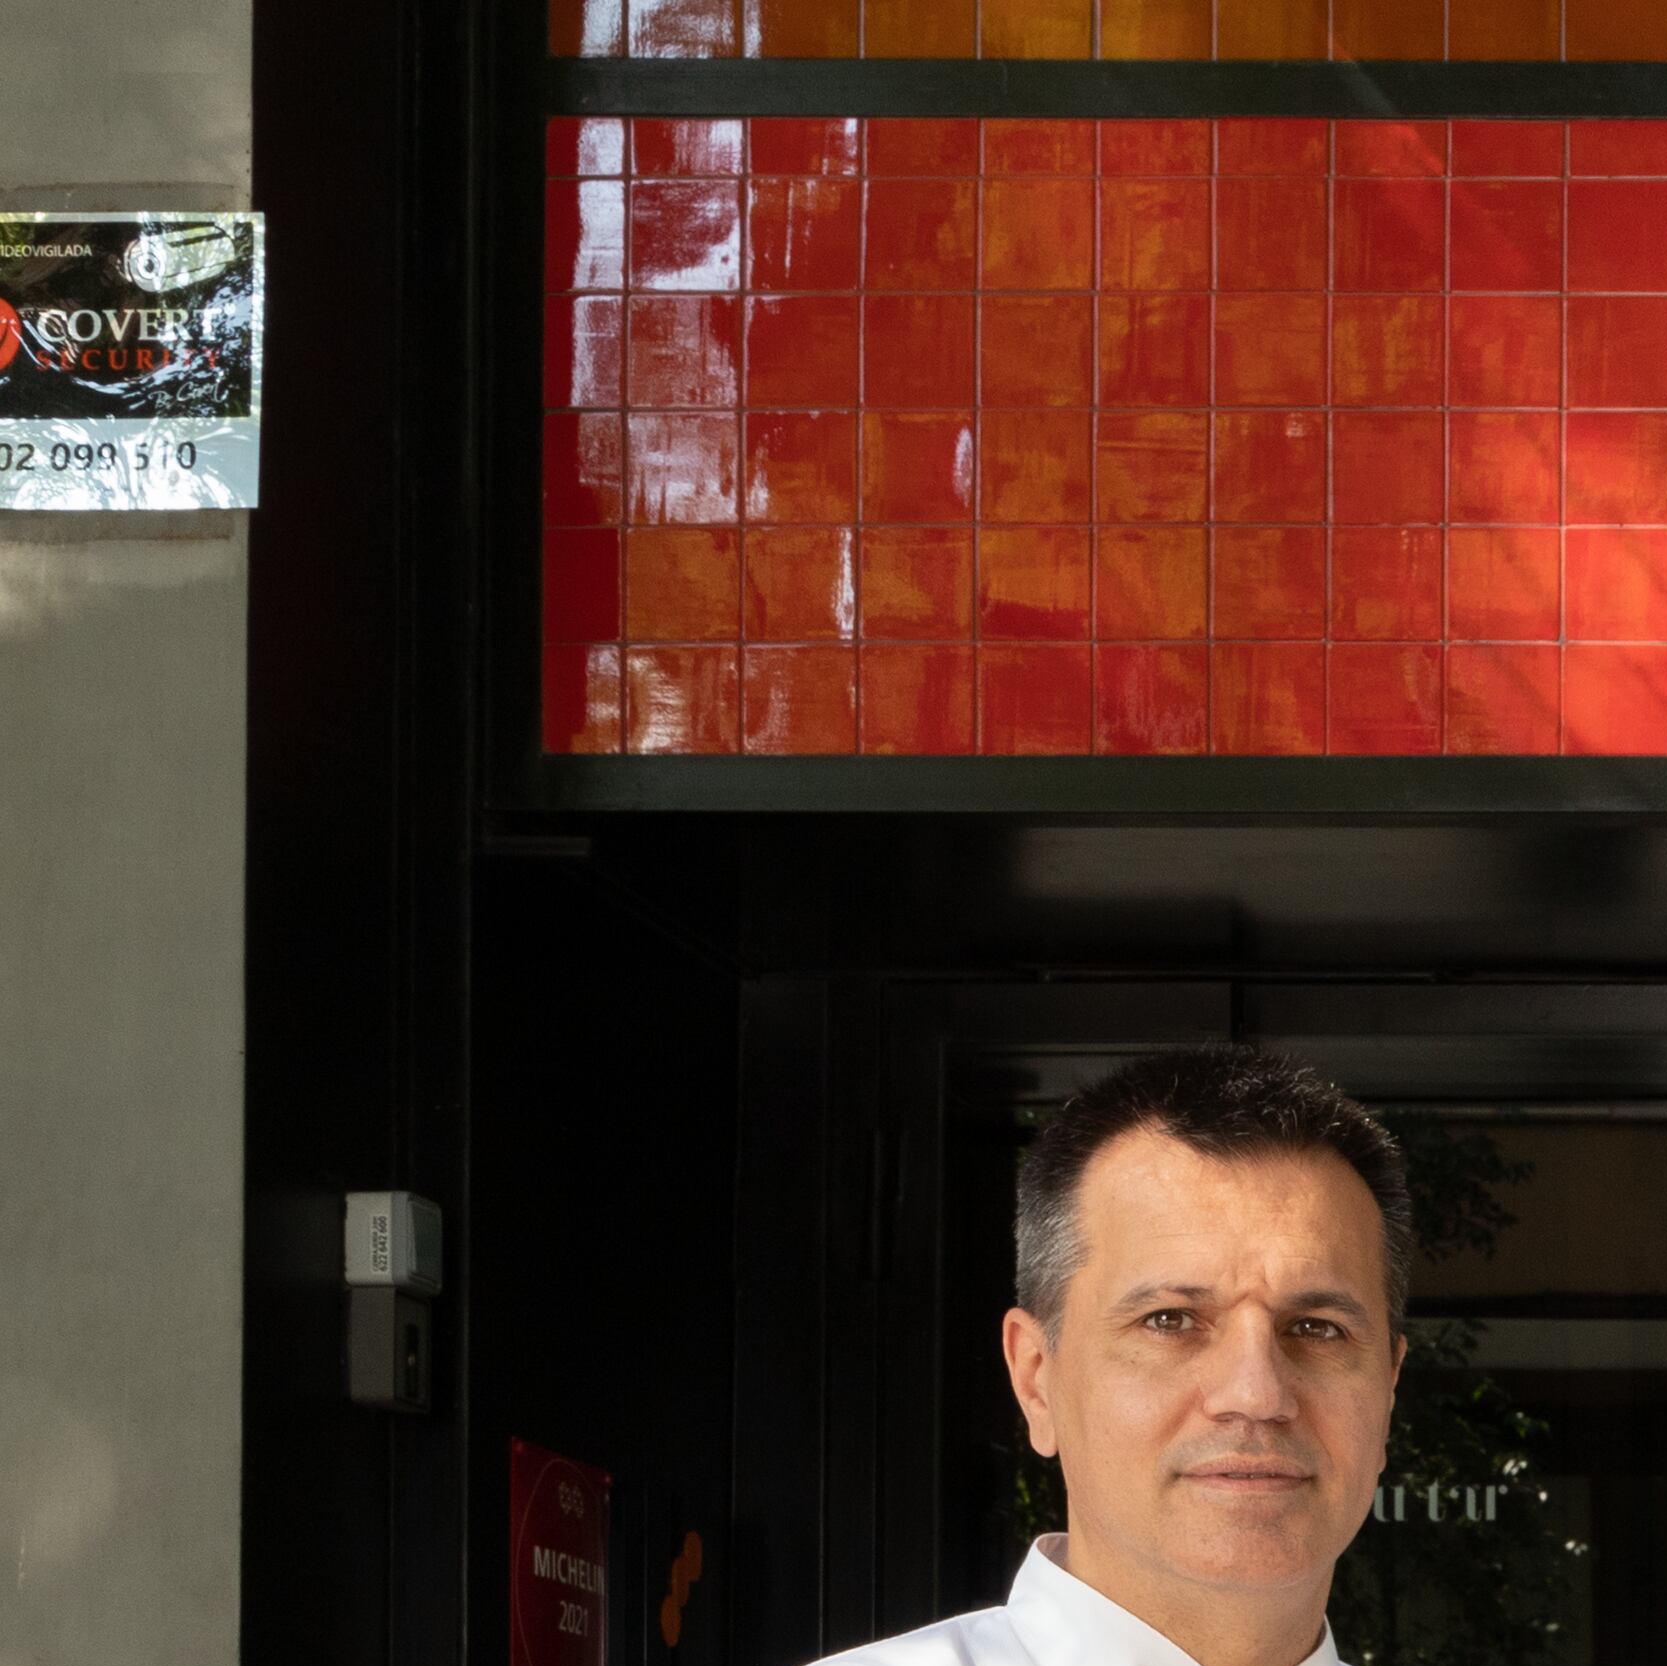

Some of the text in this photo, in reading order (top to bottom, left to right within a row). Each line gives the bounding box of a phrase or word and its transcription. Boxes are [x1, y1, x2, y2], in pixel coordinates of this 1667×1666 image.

[0, 244, 93, 257] IDEOVIGILADA
[36, 308, 222, 343] COVERT
[35, 348, 219, 373] SECURITY
[51, 442, 117, 472] 099
[533, 1544, 605, 1597] MICHELIN
[558, 1600, 590, 1639] 2021
